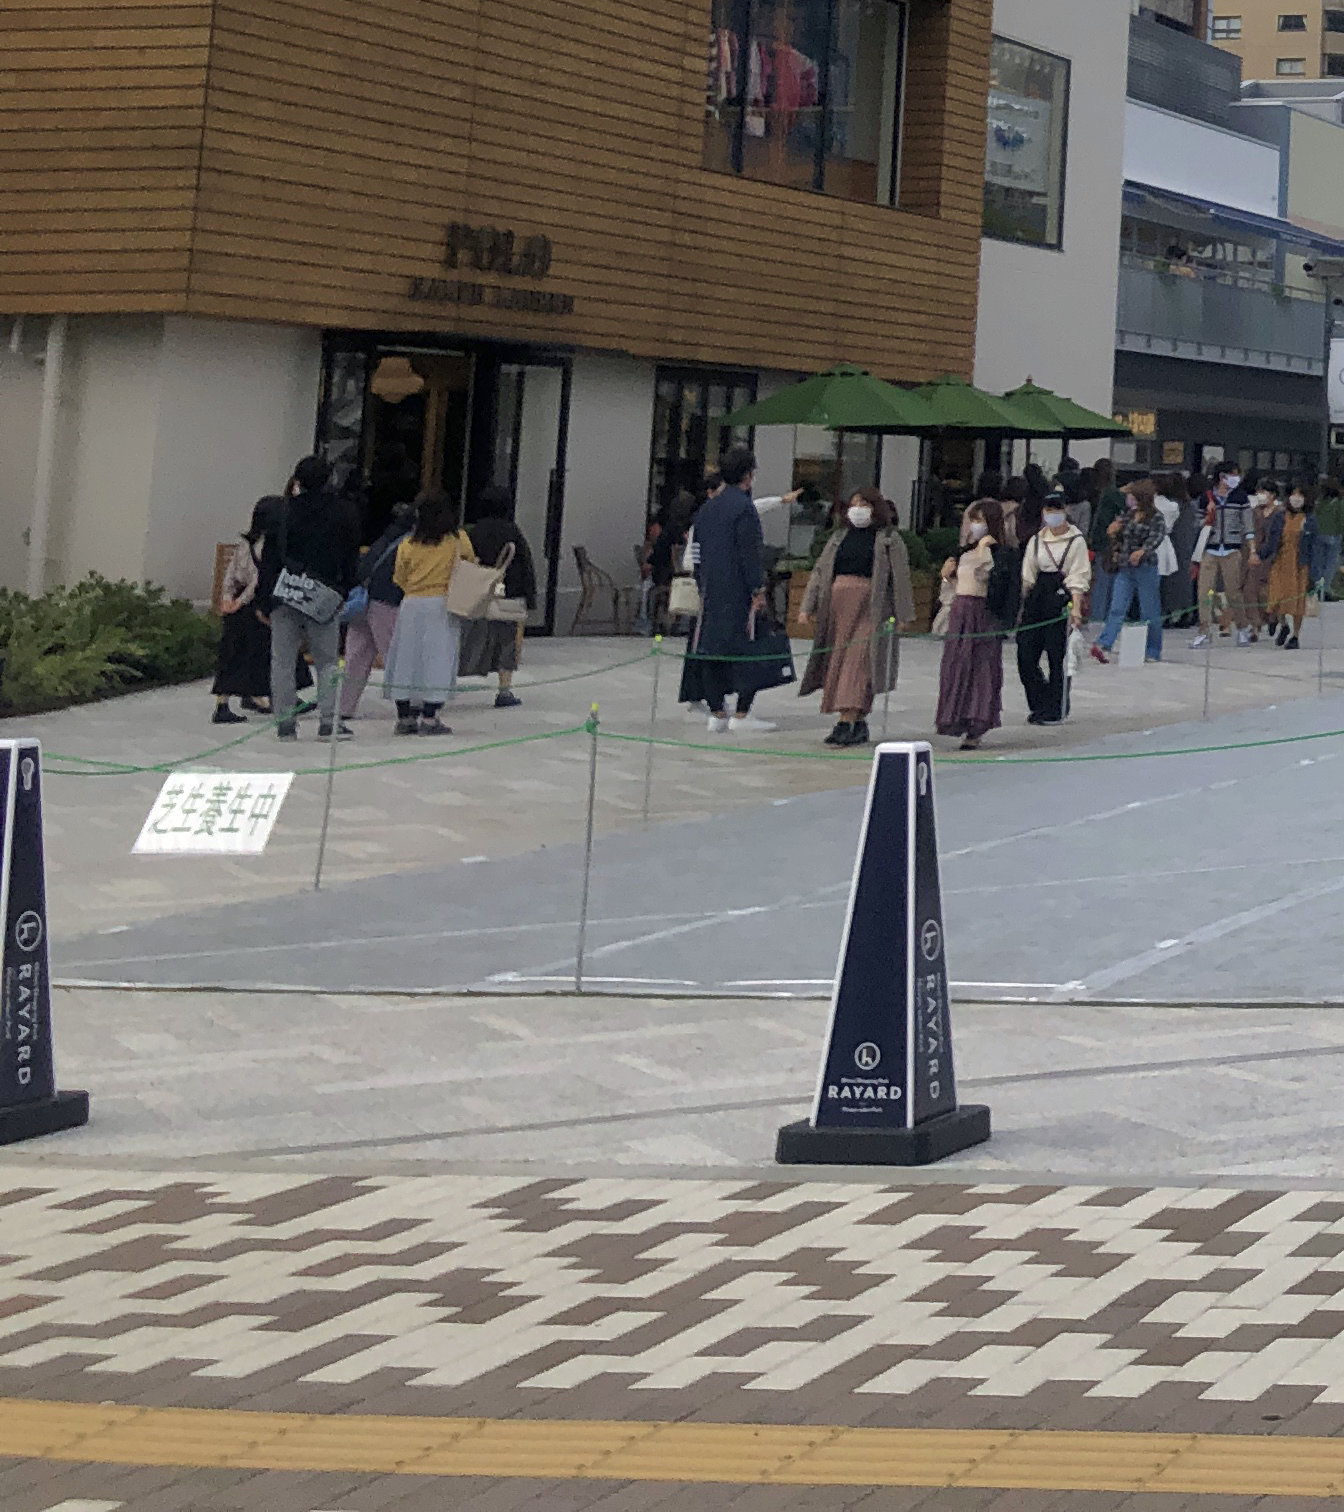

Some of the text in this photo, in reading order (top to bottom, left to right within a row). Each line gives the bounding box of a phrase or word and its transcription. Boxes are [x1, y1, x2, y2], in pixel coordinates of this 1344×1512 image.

[148, 781, 277, 836] 芝生養生中
[17, 963, 32, 1085] RAYARD
[926, 974, 941, 1099] RAYARD
[827, 1085, 902, 1099] RAYARD
